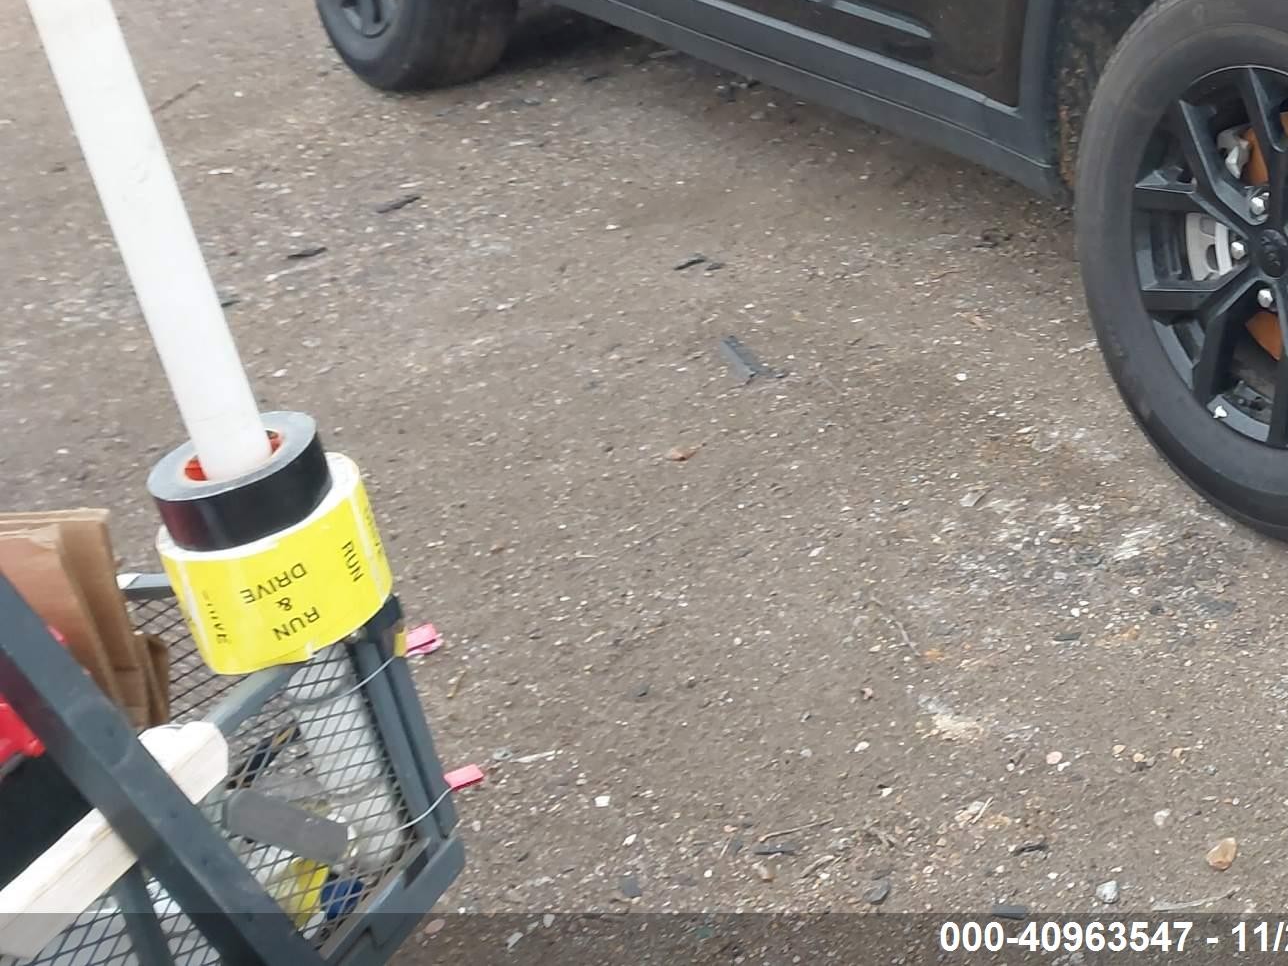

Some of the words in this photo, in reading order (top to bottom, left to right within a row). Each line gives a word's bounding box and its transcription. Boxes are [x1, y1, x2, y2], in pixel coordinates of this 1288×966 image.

[239, 562, 308, 604] DRIVE
[276, 597, 293, 611] &
[272, 606, 320, 641] RUN
